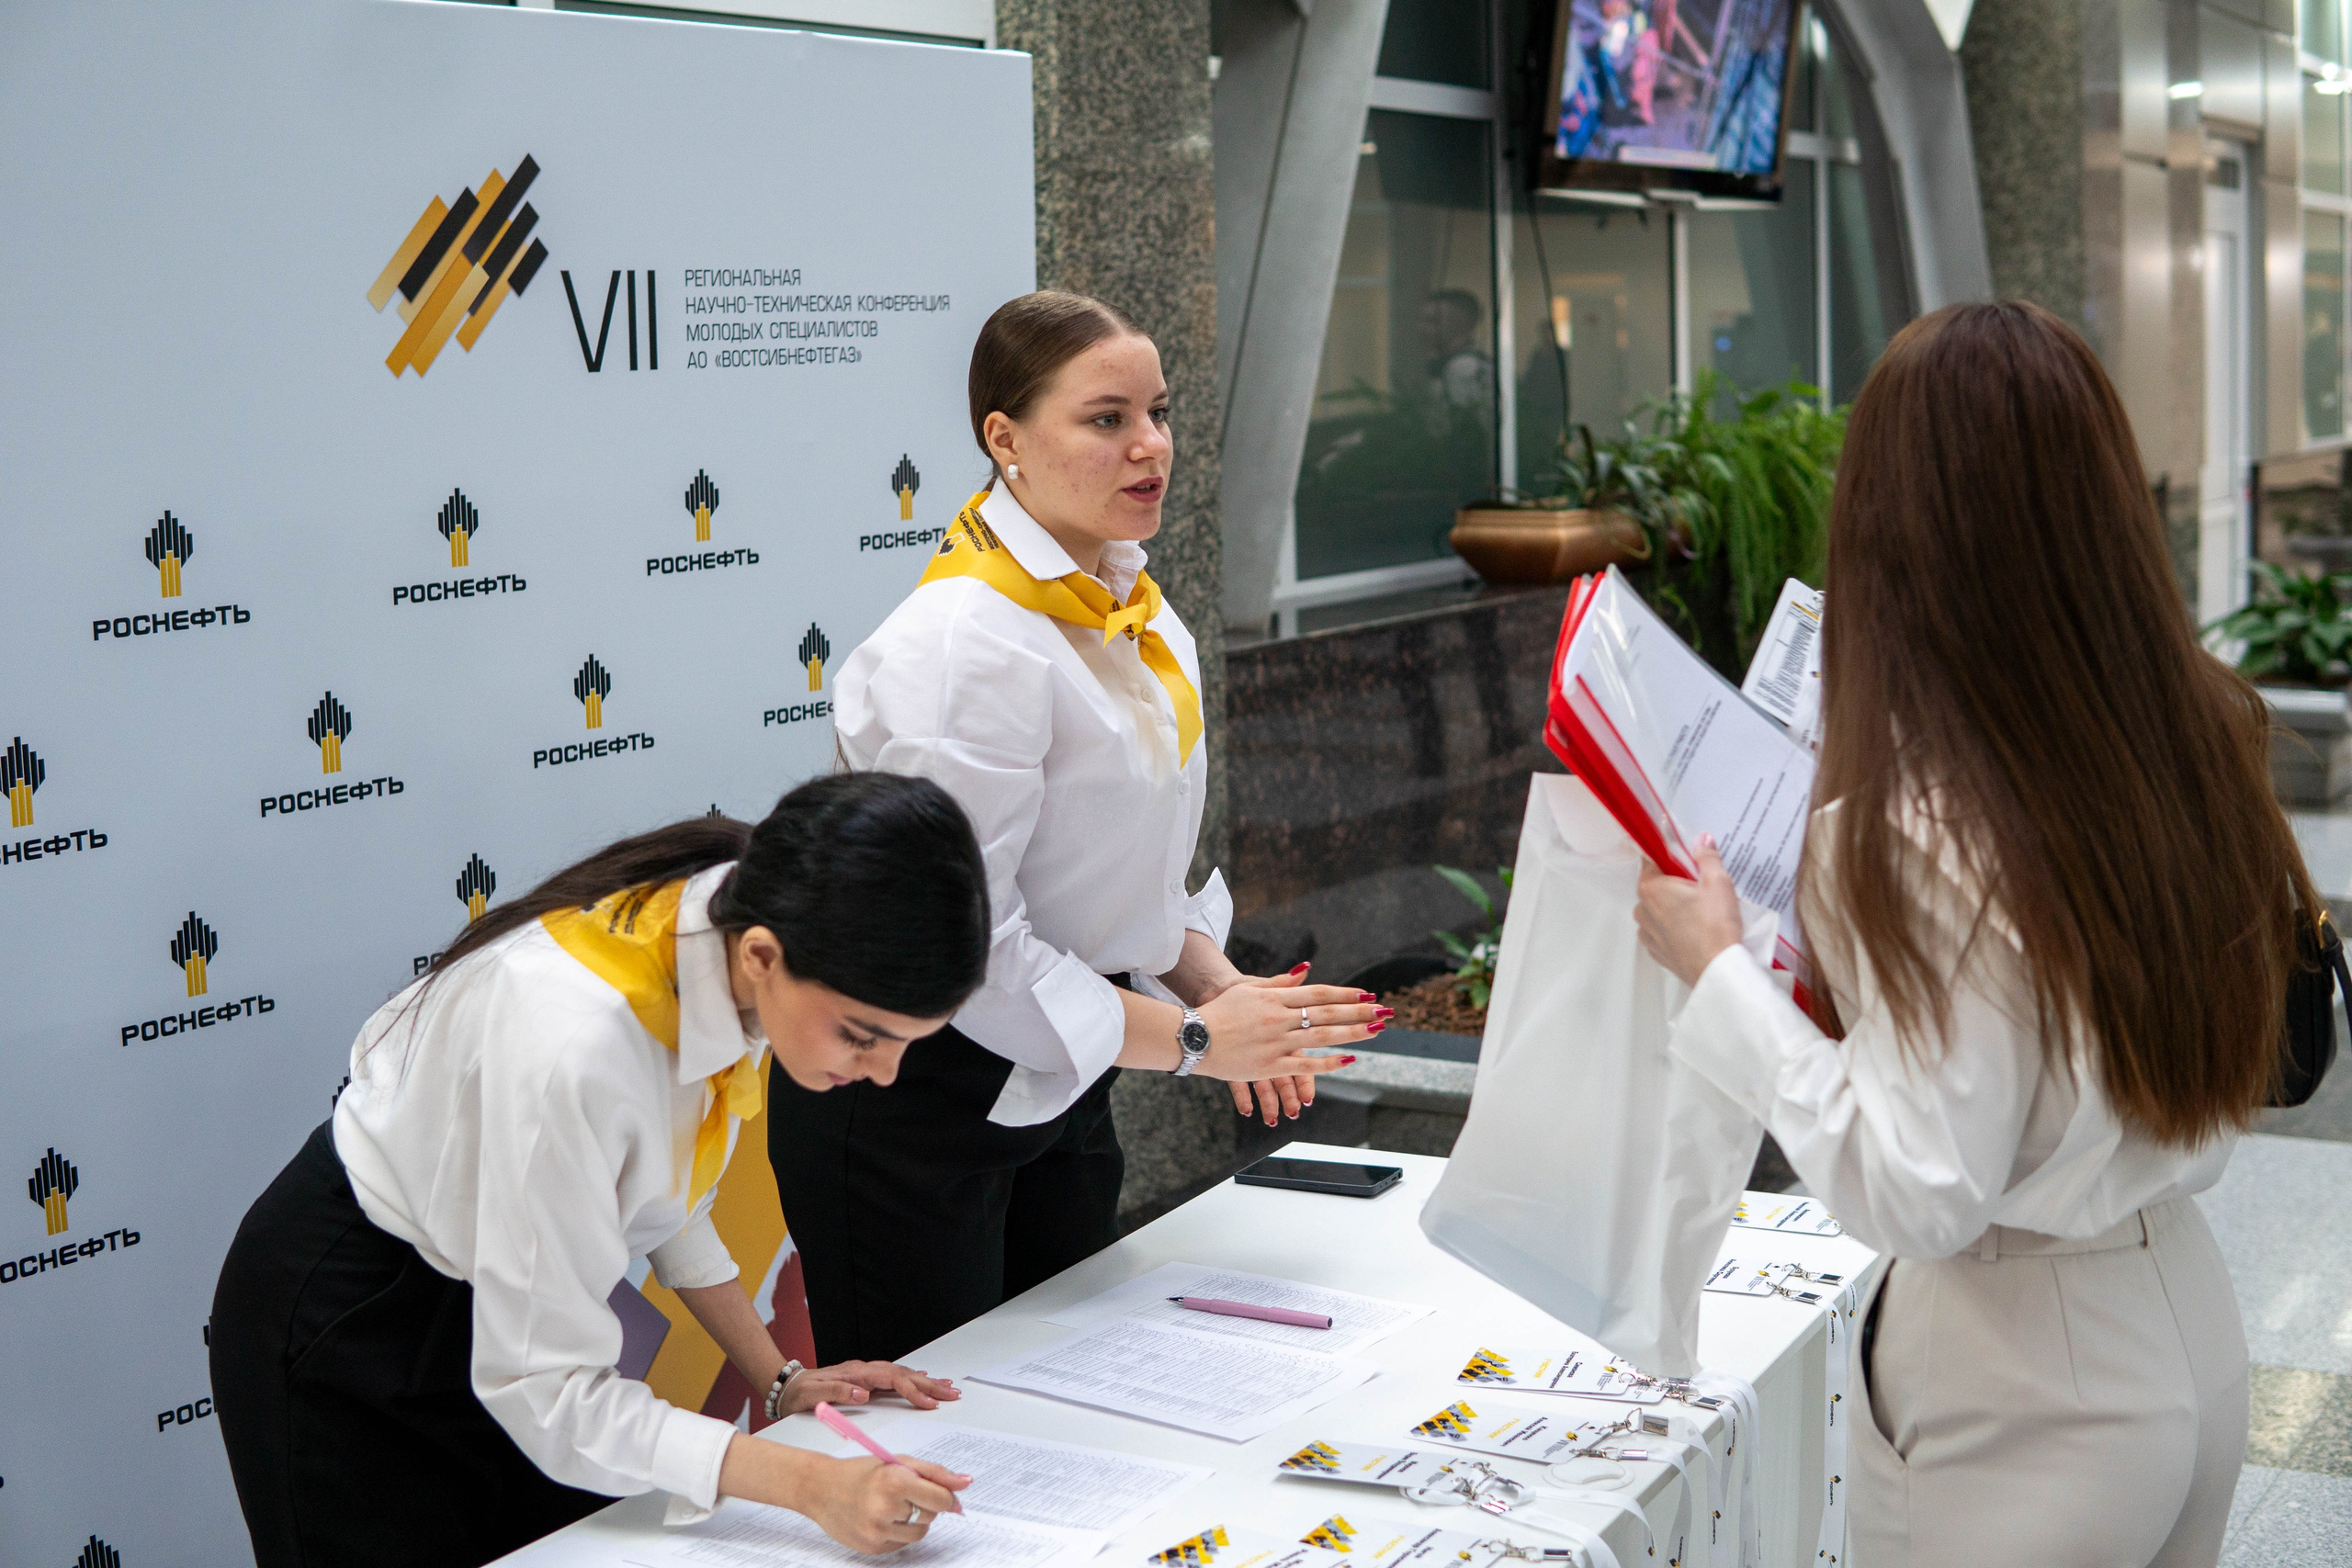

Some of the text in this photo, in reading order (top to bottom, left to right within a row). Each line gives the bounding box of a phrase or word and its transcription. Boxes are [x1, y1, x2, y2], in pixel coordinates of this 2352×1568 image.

[684, 268, 801, 288] РЕГИОНАЛЬНАЯ
[560, 269, 659, 373] VII
[685, 294, 950, 314] НАУЧНО-ТЕХНИЧЕСКАЯ КОНФЕРЕНЦИЯ
[686, 320, 878, 343] МОЛОДЫХ СПЕЦИАЛИСТОВ
[687, 346, 863, 369] АО «ВОСТСИБНЕФТЕГАЗ»
[958, 511, 986, 553] РОСНЕФТЬ
[646, 547, 760, 577] РОСНЕФТЬ
[392, 573, 526, 606] РОСНЕФТЬ
[92, 604, 251, 641] РОСНЕФТЬ
[533, 732, 655, 769] РОСНЕФТЬ
[260, 776, 404, 818] РОСНЕФТЬ
[0, 829, 108, 865] НЕФТЬ
[121, 994, 276, 1047] РОСНЕФТЬ
[157, 1396, 217, 1433] РОС
